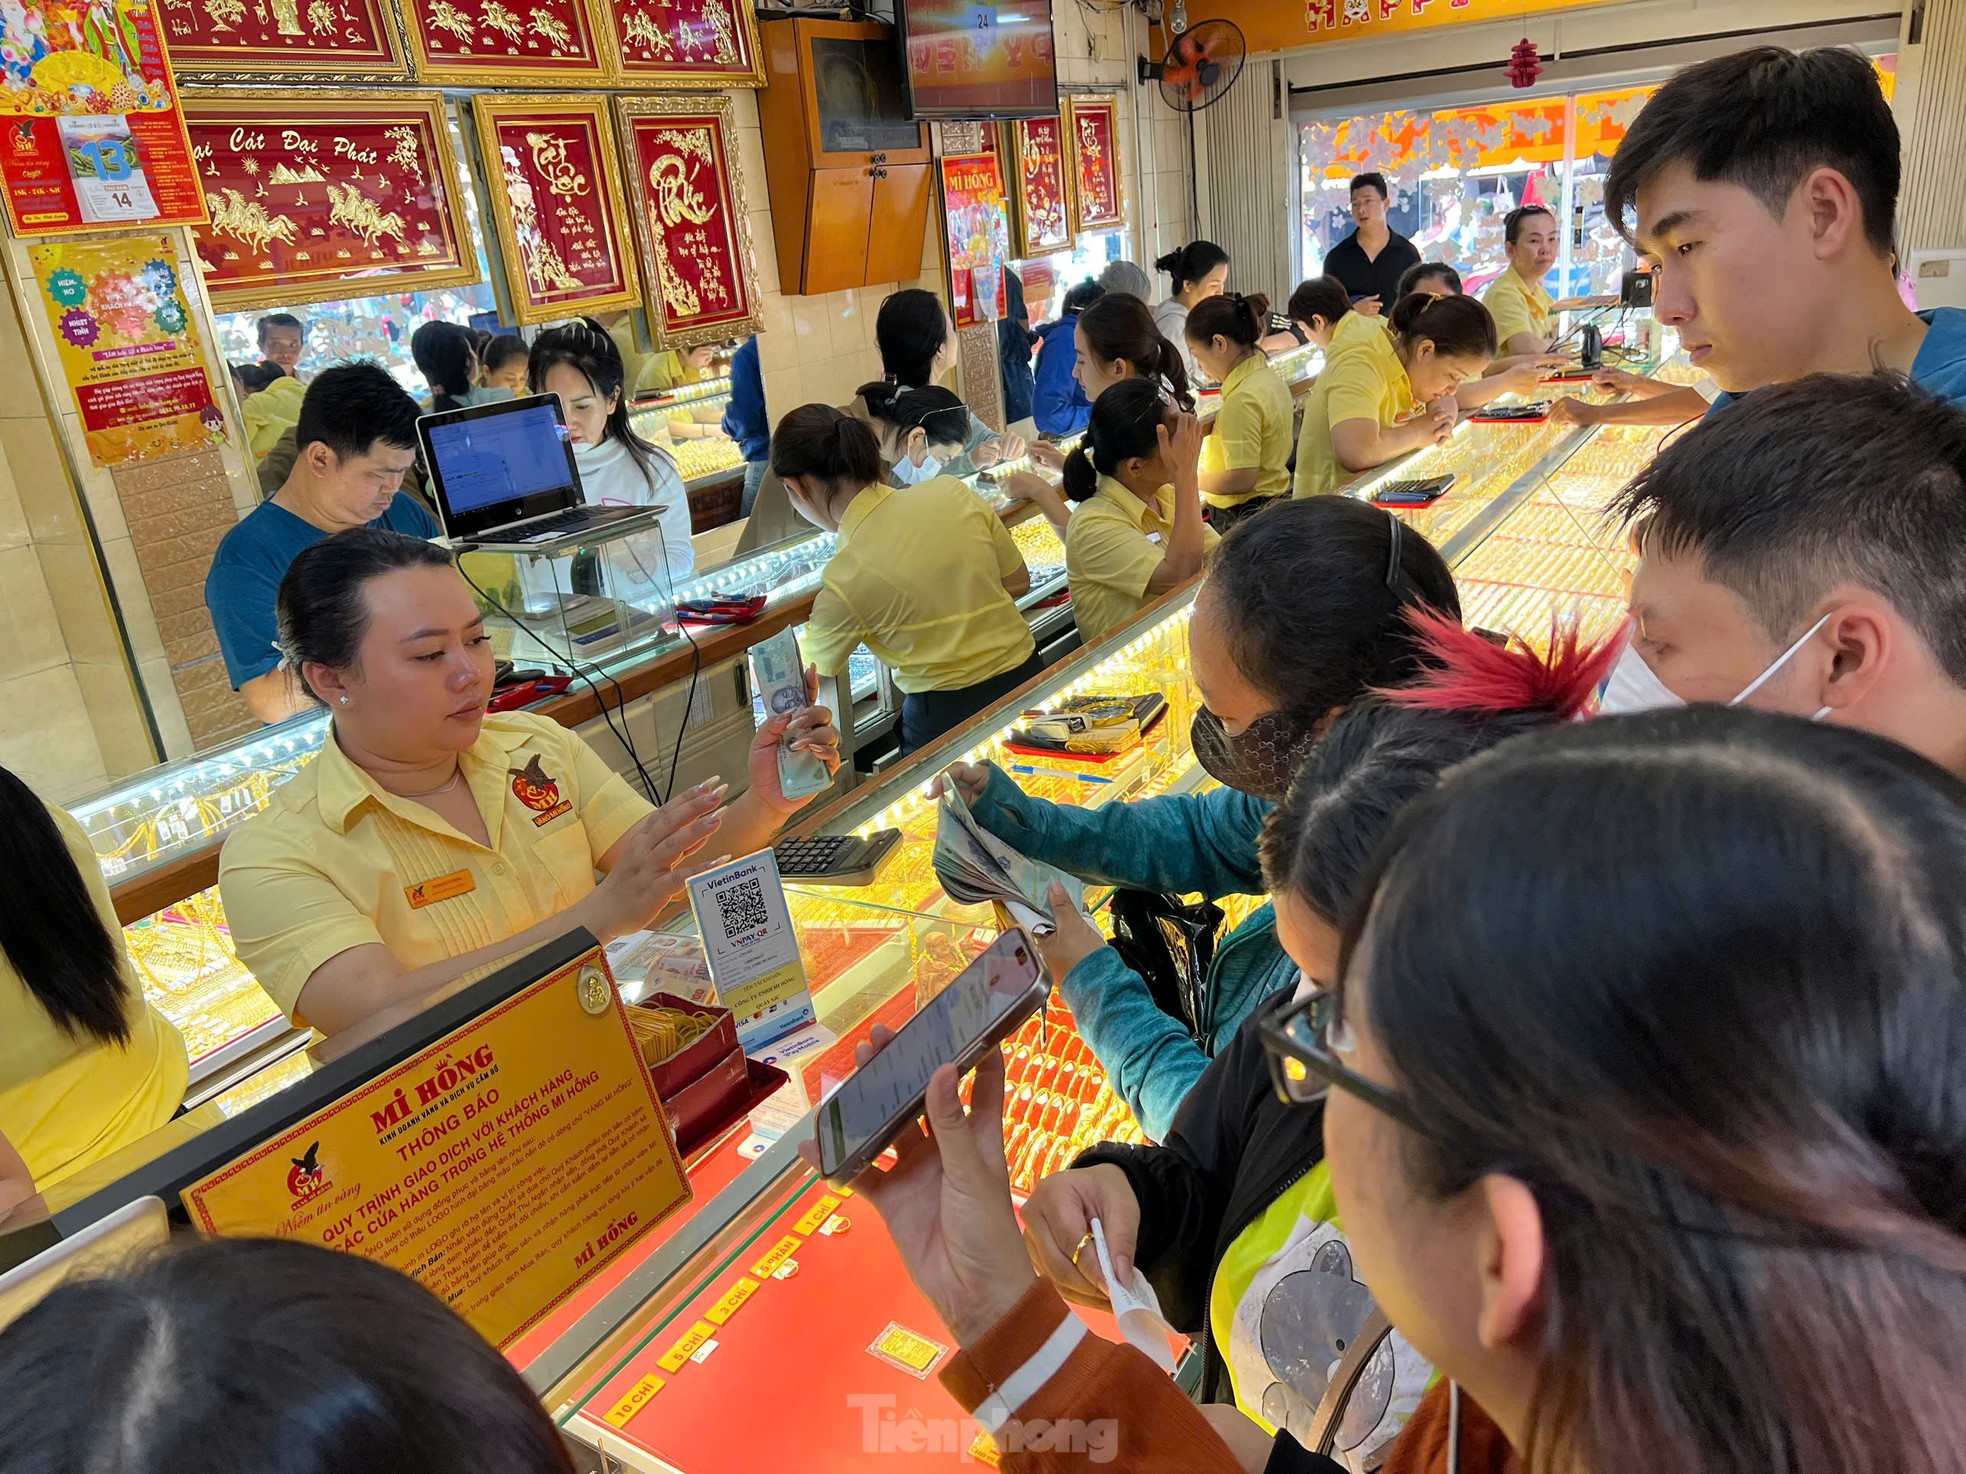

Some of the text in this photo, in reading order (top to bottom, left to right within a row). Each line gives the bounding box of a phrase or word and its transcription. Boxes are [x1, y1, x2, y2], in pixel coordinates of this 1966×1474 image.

[977, 14, 989, 29] 24
[80, 140, 132, 181] 13
[194, 127, 377, 164] ại Cát Đại Phát
[112, 193, 132, 208] 14
[707, 865, 757, 889] VietinBank
[735, 999, 749, 1007] CÔNG
[758, 987, 772, 996] TNHH
[735, 1019, 748, 1028] VISA
[415, 1044, 493, 1106] HỒNG
[380, 1064, 498, 1145] KINH DOANH VÀNG VÀ DỊCH VỤ CẦM ĐỒ
[396, 1089, 499, 1161] THÔNG BÁO
[323, 1070, 573, 1242] QUY TRÌNH GIAO DỊCH VỚI KHÁCH HÀNG
[368, 1209, 398, 1234] CỬA
[400, 1180, 439, 1212] HÀNG
[440, 1148, 486, 1181] TRONG
[488, 1132, 506, 1152] HỆ
[507, 1104, 550, 1137] THỐNG
[552, 1094, 564, 1108] MI
[566, 1071, 599, 1098] HỒNG
[316, 1201, 332, 1216] tin
[334, 1183, 361, 1204] vàng
[385, 1146, 521, 1243] luôn dụng đồng phục và bảng tên như
[400, 1237, 408, 1246] có
[410, 1226, 426, 1239] thêu
[427, 1208, 449, 1226] LOGO
[496, 1167, 510, 1178] màu
[426, 1235, 448, 1254] LOGO
[450, 1226, 460, 1238] ghi
[469, 1211, 479, 1223] họ
[480, 1205, 491, 1215] tên
[492, 1198, 500, 1206] và
[517, 1175, 532, 1189] công
[428, 1137, 601, 1266] Bán: Nhân viên Quầy cho Quý Khách phiếu
[464, 1237, 482, 1253] phiếu
[484, 1226, 497, 1237] đến
[498, 1212, 515, 1226] Quầy
[531, 1188, 548, 1202] Ngân
[597, 1211, 638, 1251] HỒNG
[462, 1250, 480, 1266] Ngân
[467, 1274, 481, 1288] Quý
[483, 1259, 503, 1276] khách
[505, 1247, 518, 1260] giao
[533, 1229, 541, 1237] và
[559, 1204, 575, 1217] hàng
[471, 1210, 598, 1310] trong giao dịch Mua khách hàng
[766, 1241, 795, 1266] PHÂN
[451, 1272, 469, 1287] bảng
[470, 1263, 481, 1272] tên
[719, 1287, 749, 1315] 3 CHỈ
[674, 1353, 684, 1361] 5
[682, 1332, 704, 1353] CHỈ
[614, 1381, 654, 1419] 10 CHỈ
